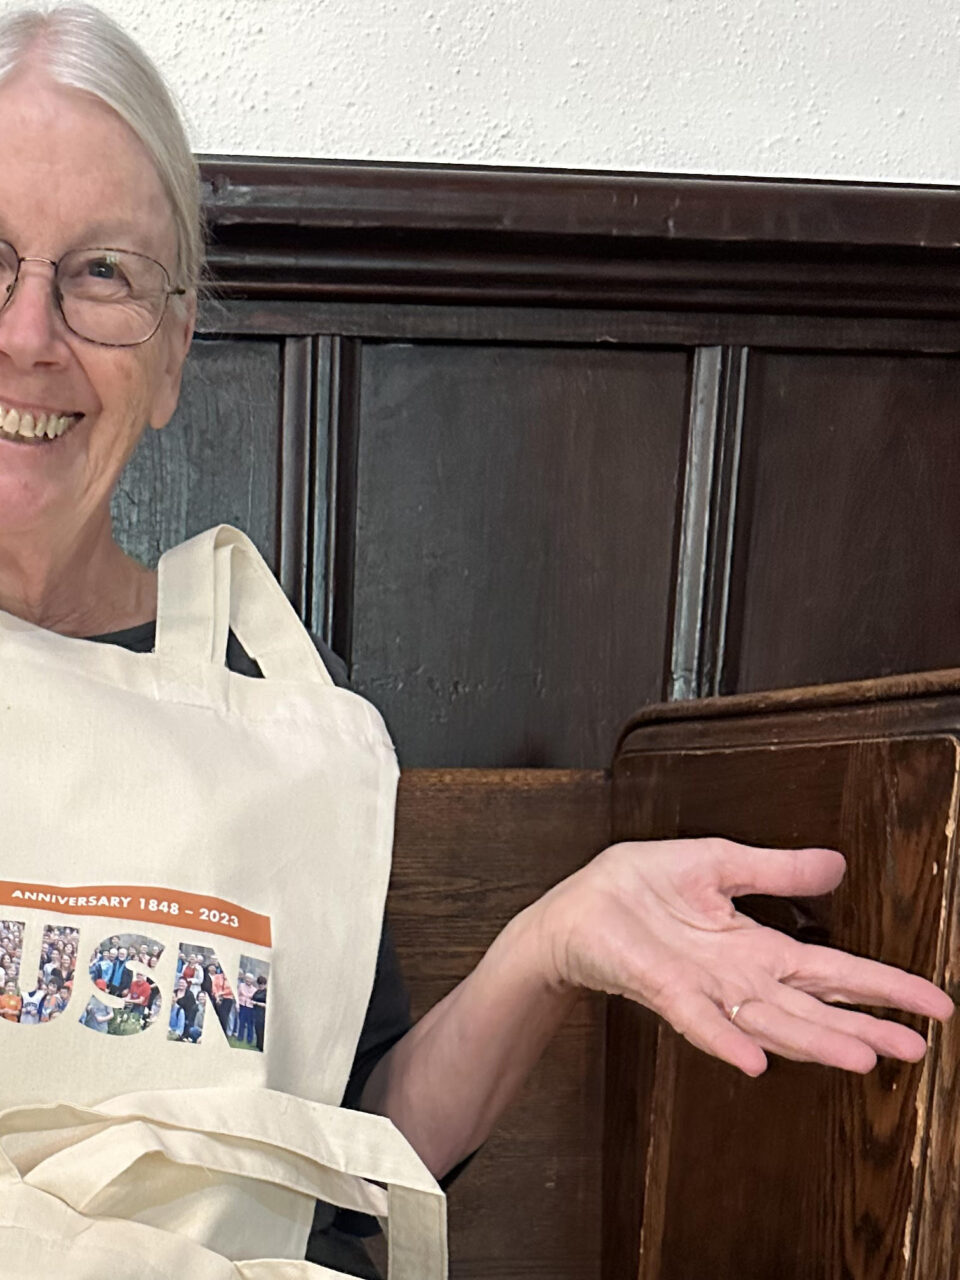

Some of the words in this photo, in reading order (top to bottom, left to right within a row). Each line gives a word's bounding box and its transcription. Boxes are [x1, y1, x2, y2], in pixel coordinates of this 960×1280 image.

[11, 889, 132, 908] ANNIVERSARY
[139, 898, 180, 915] 1848
[198, 908, 240, 928] 2023
